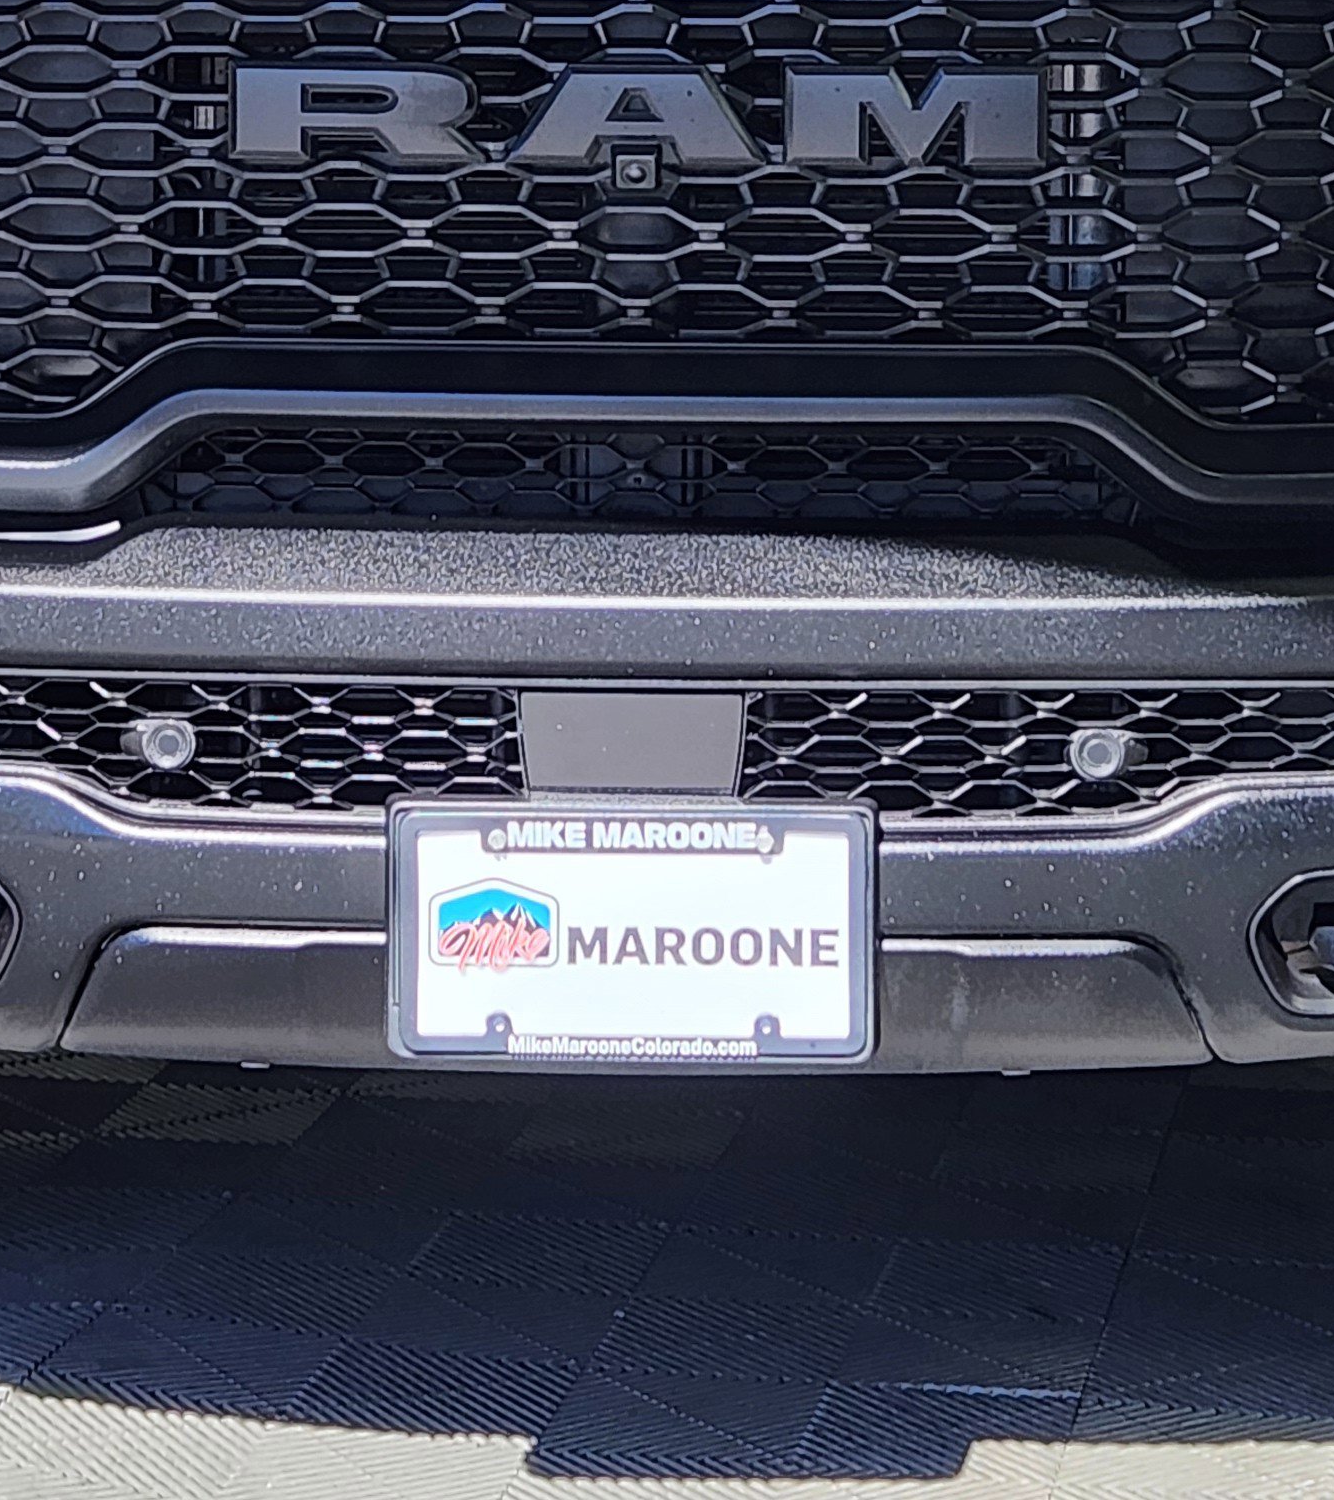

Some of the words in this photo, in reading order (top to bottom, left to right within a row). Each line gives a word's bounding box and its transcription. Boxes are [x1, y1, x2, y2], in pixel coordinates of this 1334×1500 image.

[229, 61, 1048, 167] RAM
[506, 821, 586, 849] MIKE
[593, 821, 757, 850] MAROONE
[438, 918, 551, 974] Mike
[567, 926, 840, 968] MAROONE
[507, 1035, 758, 1056] MikeMarooneColorado.com
